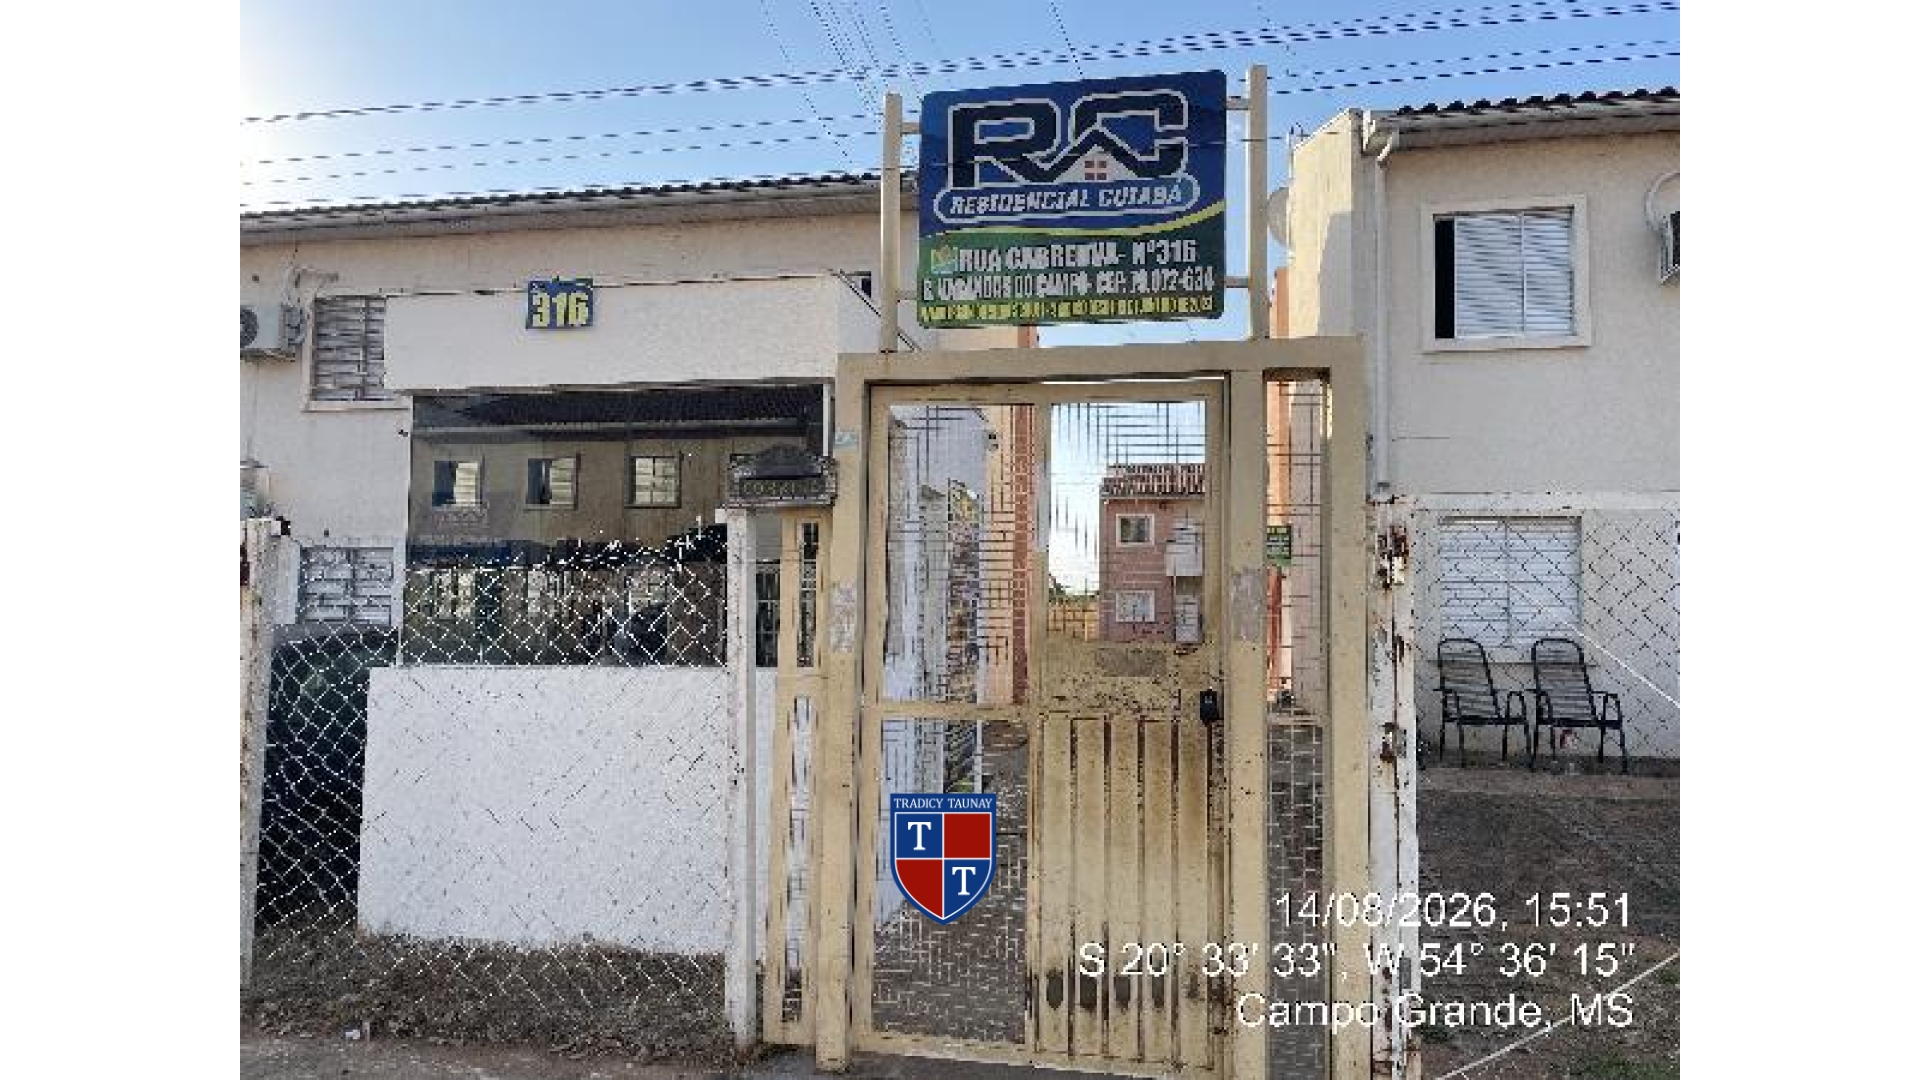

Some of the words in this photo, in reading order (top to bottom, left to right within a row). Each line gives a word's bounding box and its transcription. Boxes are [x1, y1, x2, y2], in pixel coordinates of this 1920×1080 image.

[948, 89, 1189, 189] RC
[950, 189, 1089, 215] RESIDENCIAL
[959, 248, 1001, 272] RUA
[532, 292, 589, 327] 316
